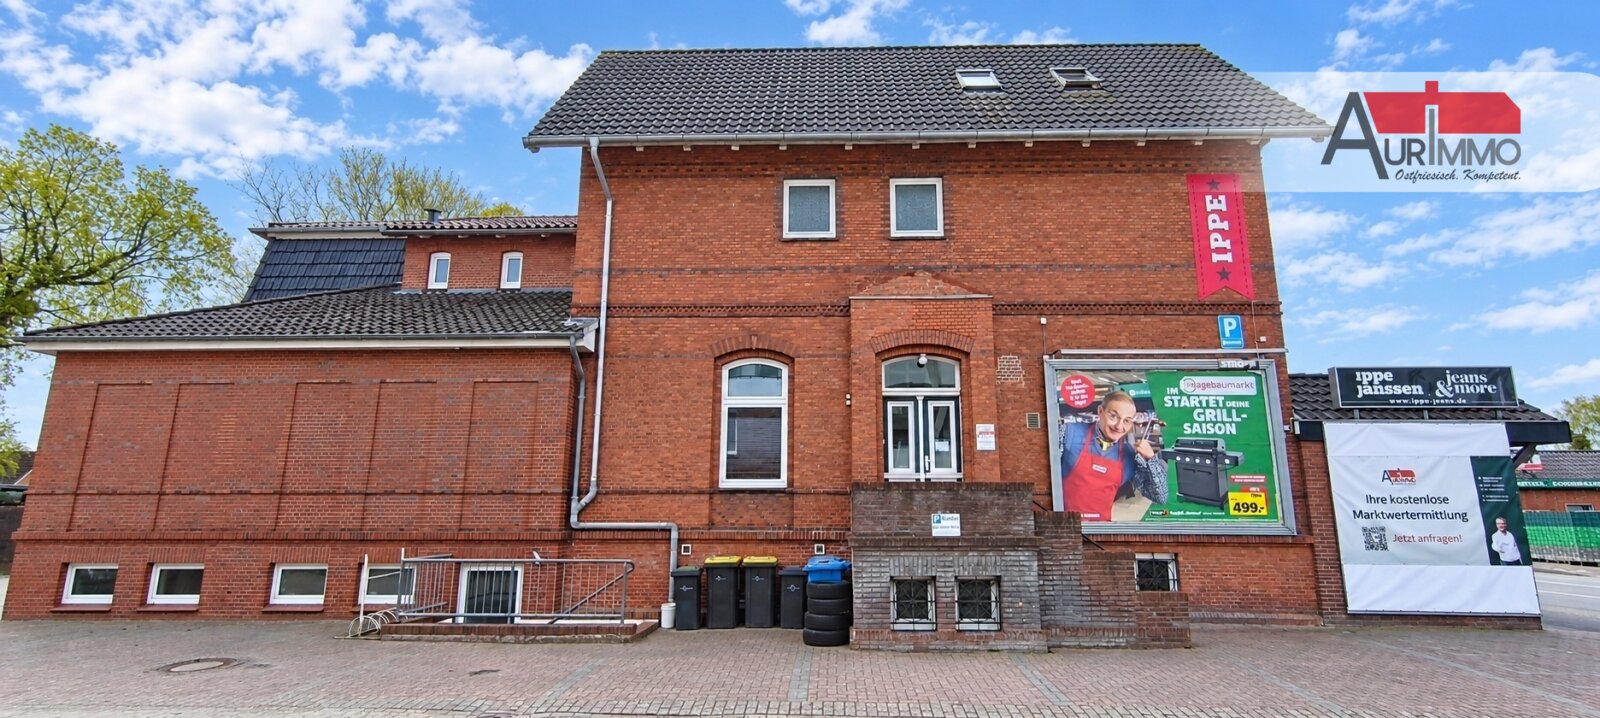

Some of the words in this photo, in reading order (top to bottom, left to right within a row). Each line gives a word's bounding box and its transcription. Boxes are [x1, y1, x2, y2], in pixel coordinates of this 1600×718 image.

[1205, 195, 1233, 263] IPPE
[1223, 317, 1237, 338] P
[1356, 371, 1393, 384] ippe
[1446, 370, 1487, 387] jeans
[1167, 387, 1178, 395] IM
[1357, 384, 1424, 398] janssen
[1435, 380, 1454, 398] &
[1455, 384, 1497, 394] more
[1163, 395, 1224, 408] STARTET
[1193, 408, 1247, 422] GRILL-
[1183, 422, 1237, 435] SAISON
[1366, 494, 1387, 504] Ihre
[1390, 494, 1449, 504] kostenlose
[1353, 509, 1469, 522] Marktwertermittlung
[1393, 534, 1416, 543] Jetzt
[1418, 534, 1463, 545] anfragen!
